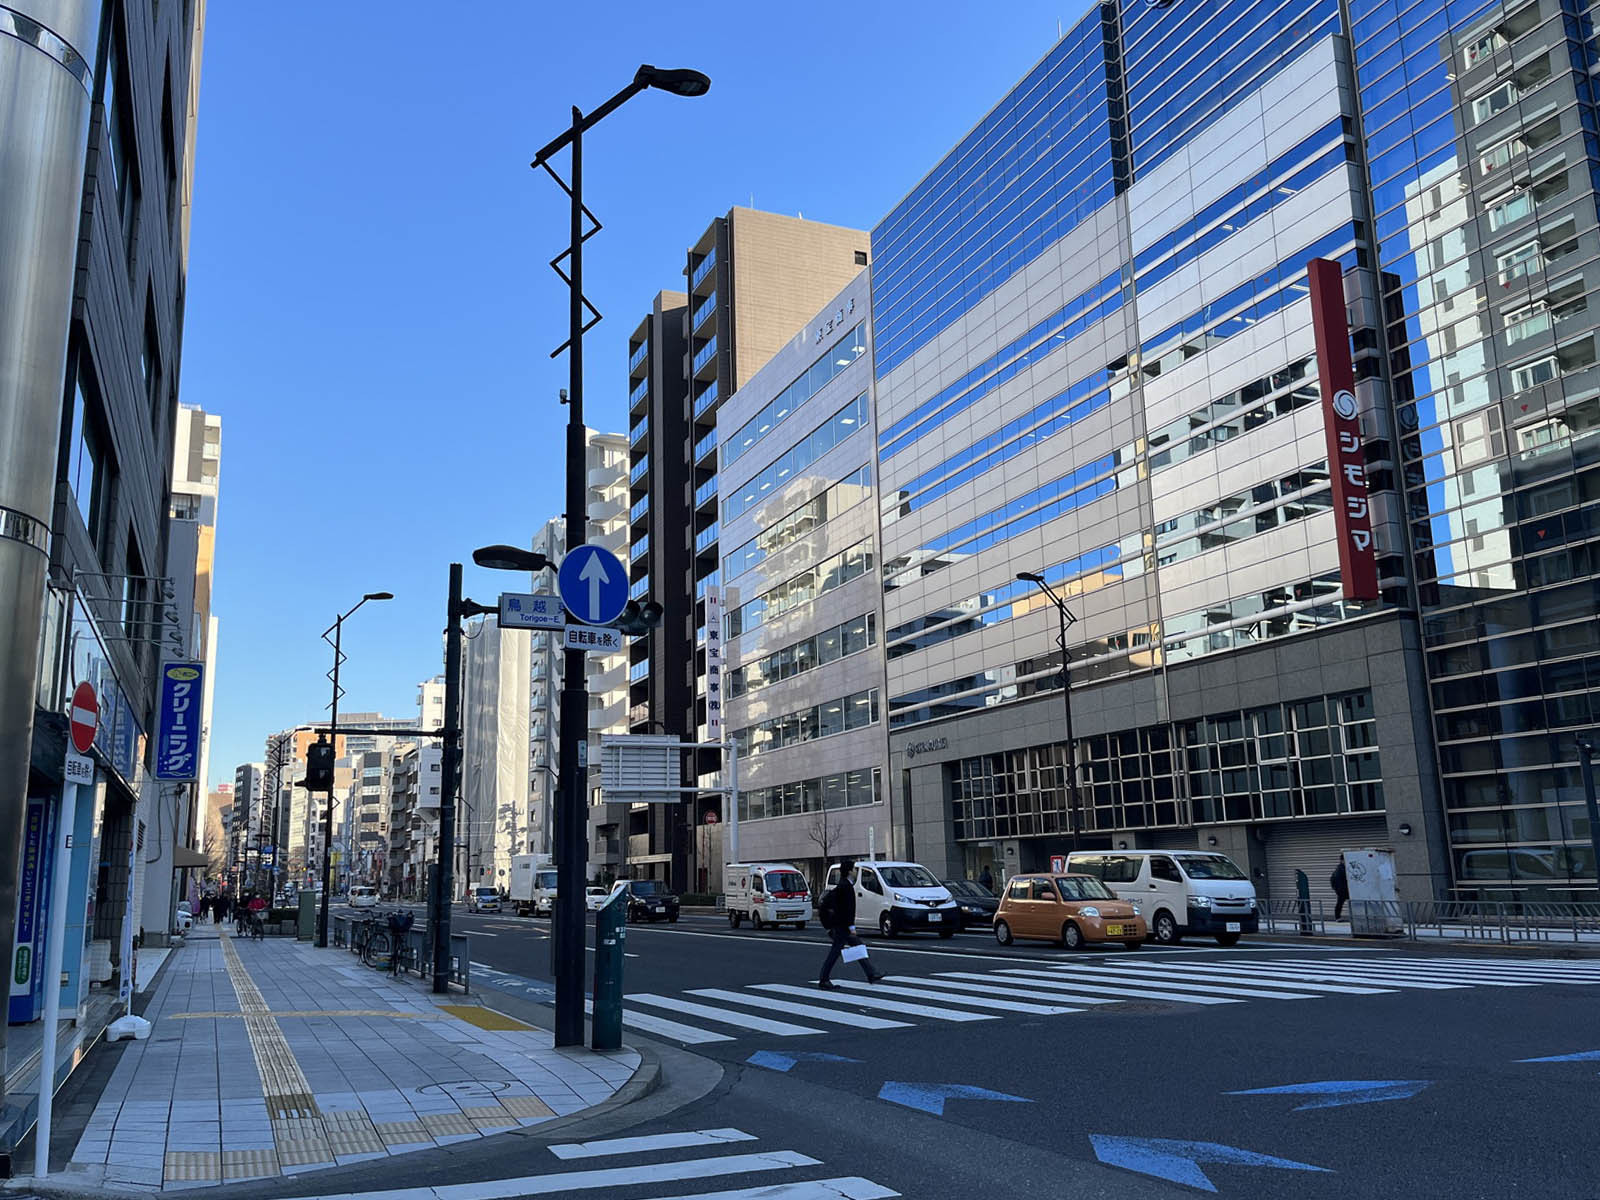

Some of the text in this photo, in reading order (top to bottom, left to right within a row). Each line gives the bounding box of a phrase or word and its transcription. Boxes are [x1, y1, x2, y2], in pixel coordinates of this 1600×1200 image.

[1339, 431, 1371, 552] シモジマ
[568, 630, 618, 648] 自転車を除く
[168, 682, 192, 771] クリーニング
